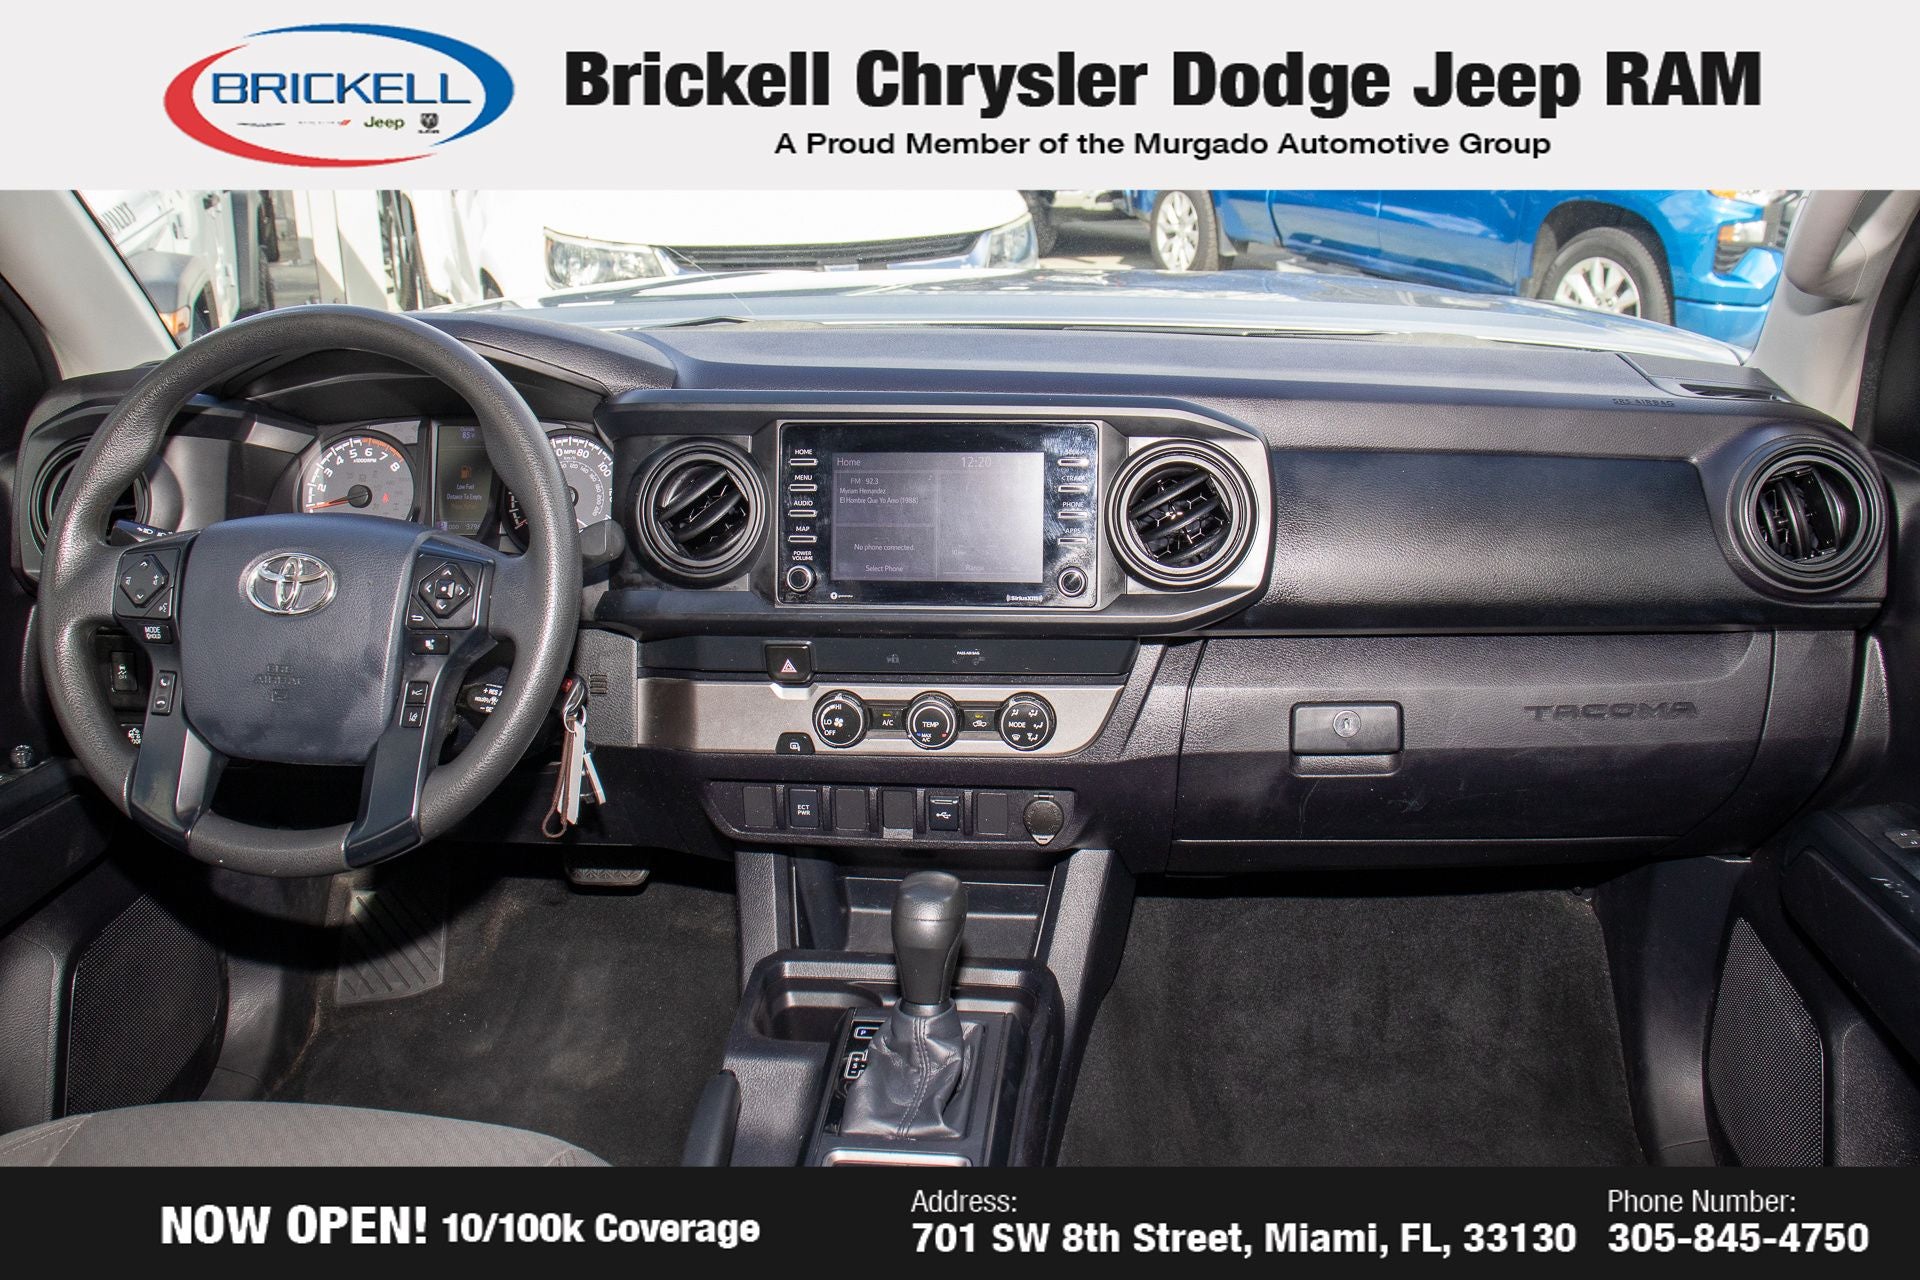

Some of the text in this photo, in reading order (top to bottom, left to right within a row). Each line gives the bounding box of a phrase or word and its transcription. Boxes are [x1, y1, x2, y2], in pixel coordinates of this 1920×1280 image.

[349, 449, 358, 458] 5
[364, 448, 373, 457] 6
[379, 452, 388, 461] 7
[577, 449, 589, 458] 80
[336, 456, 344, 465] 4
[836, 457, 861, 467] Home
[961, 456, 992, 468] 12:20
[390, 462, 400, 472] 8
[598, 462, 611, 477] 100
[323, 468, 333, 477] 3
[317, 484, 326, 492] 2
[853, 543, 864, 551] No
[864, 543, 883, 552] phone
[145, 626, 161, 634] MODE
[1524, 702, 1697, 721] TACOMA
[882, 719, 894, 727] A/C
[922, 721, 940, 729] TEMP
[1008, 721, 1027, 729] MODE
